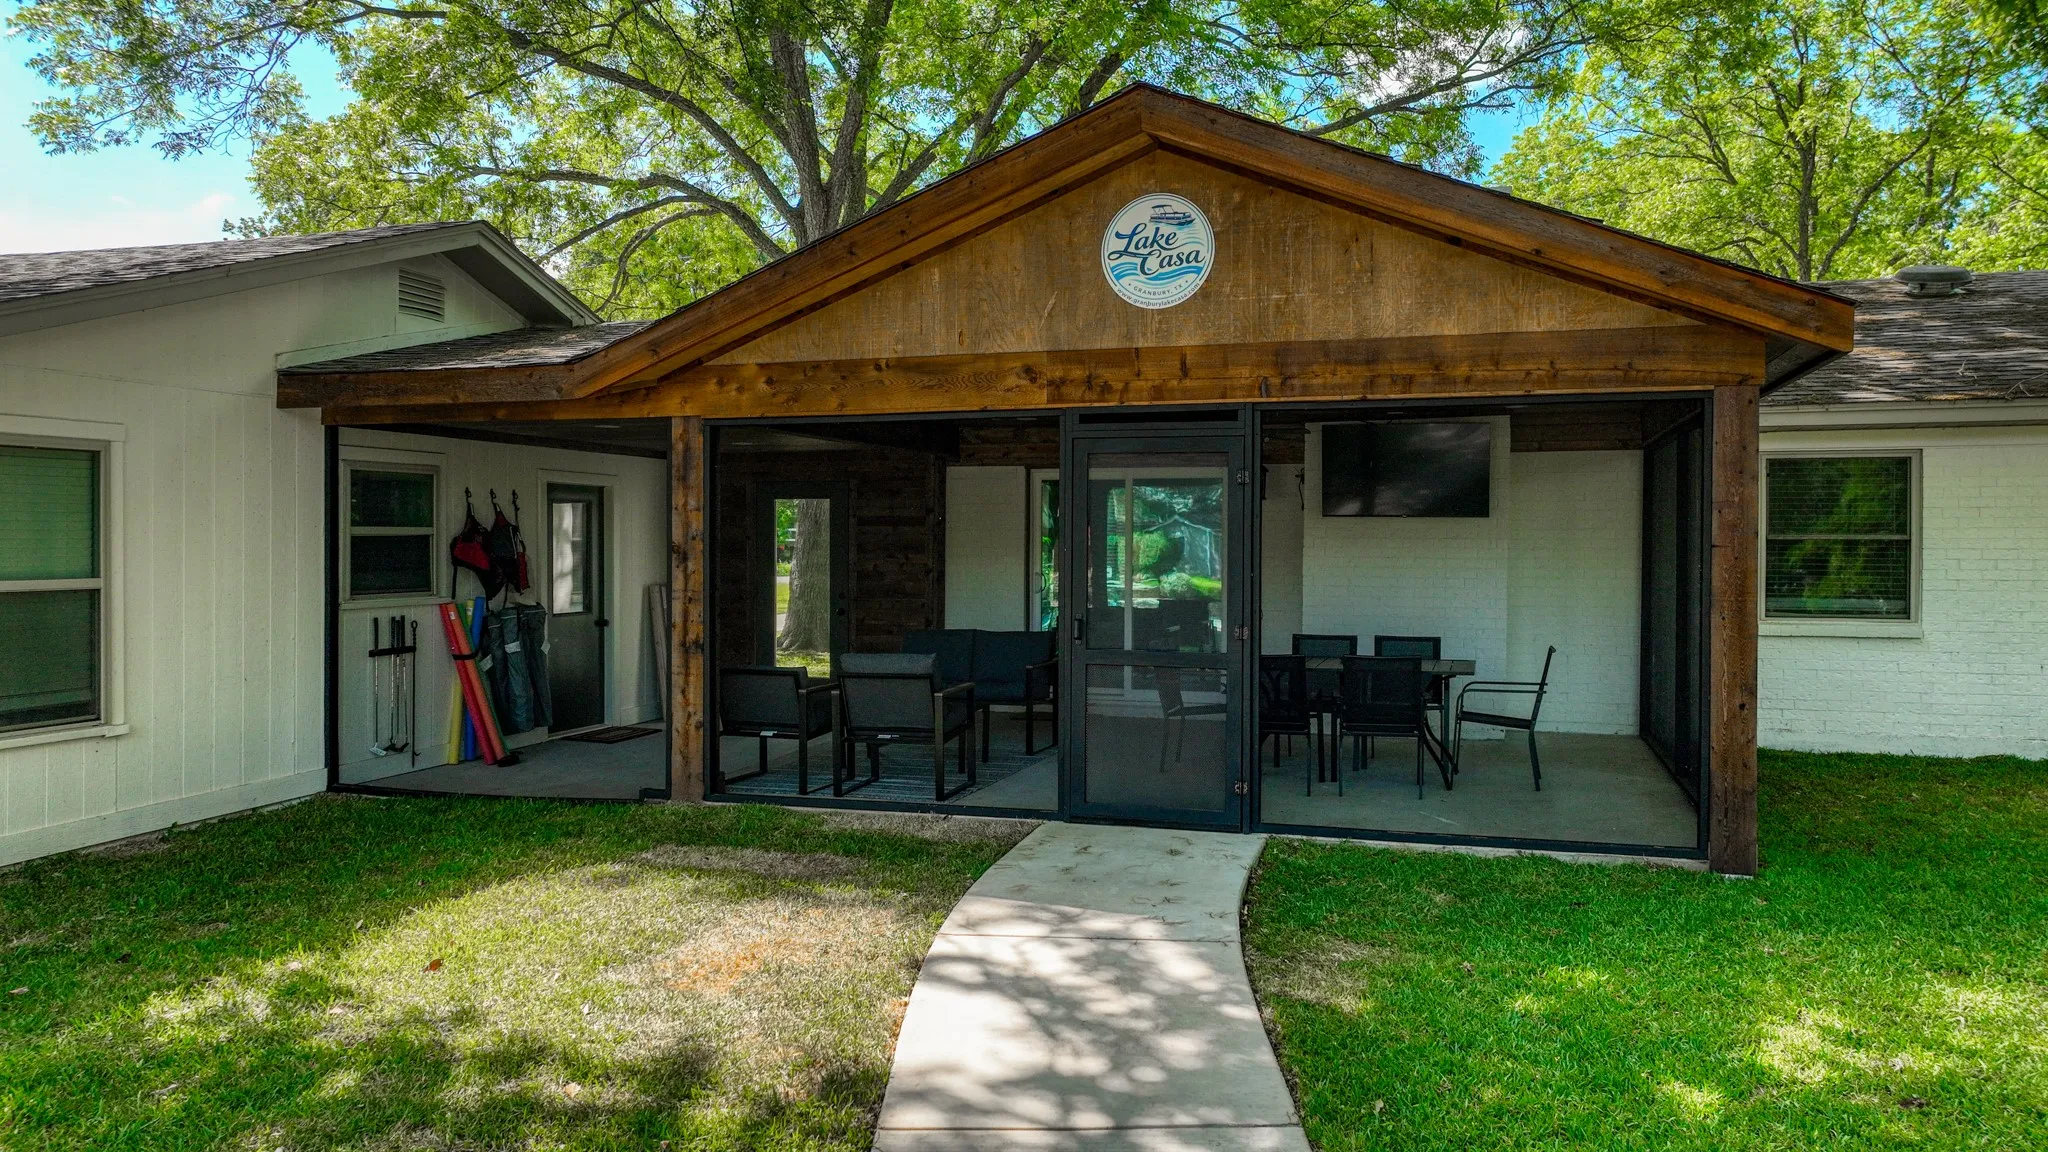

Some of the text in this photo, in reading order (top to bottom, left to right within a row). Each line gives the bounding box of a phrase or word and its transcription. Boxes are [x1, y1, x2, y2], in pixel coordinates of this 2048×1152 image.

[1108, 222, 1179, 261] Lake
[1139, 249, 1206, 276] Casa
[1117, 282, 1200, 307] www.granburylakecasa.com
[1133, 283, 1183, 296] GRANBURY, TX
